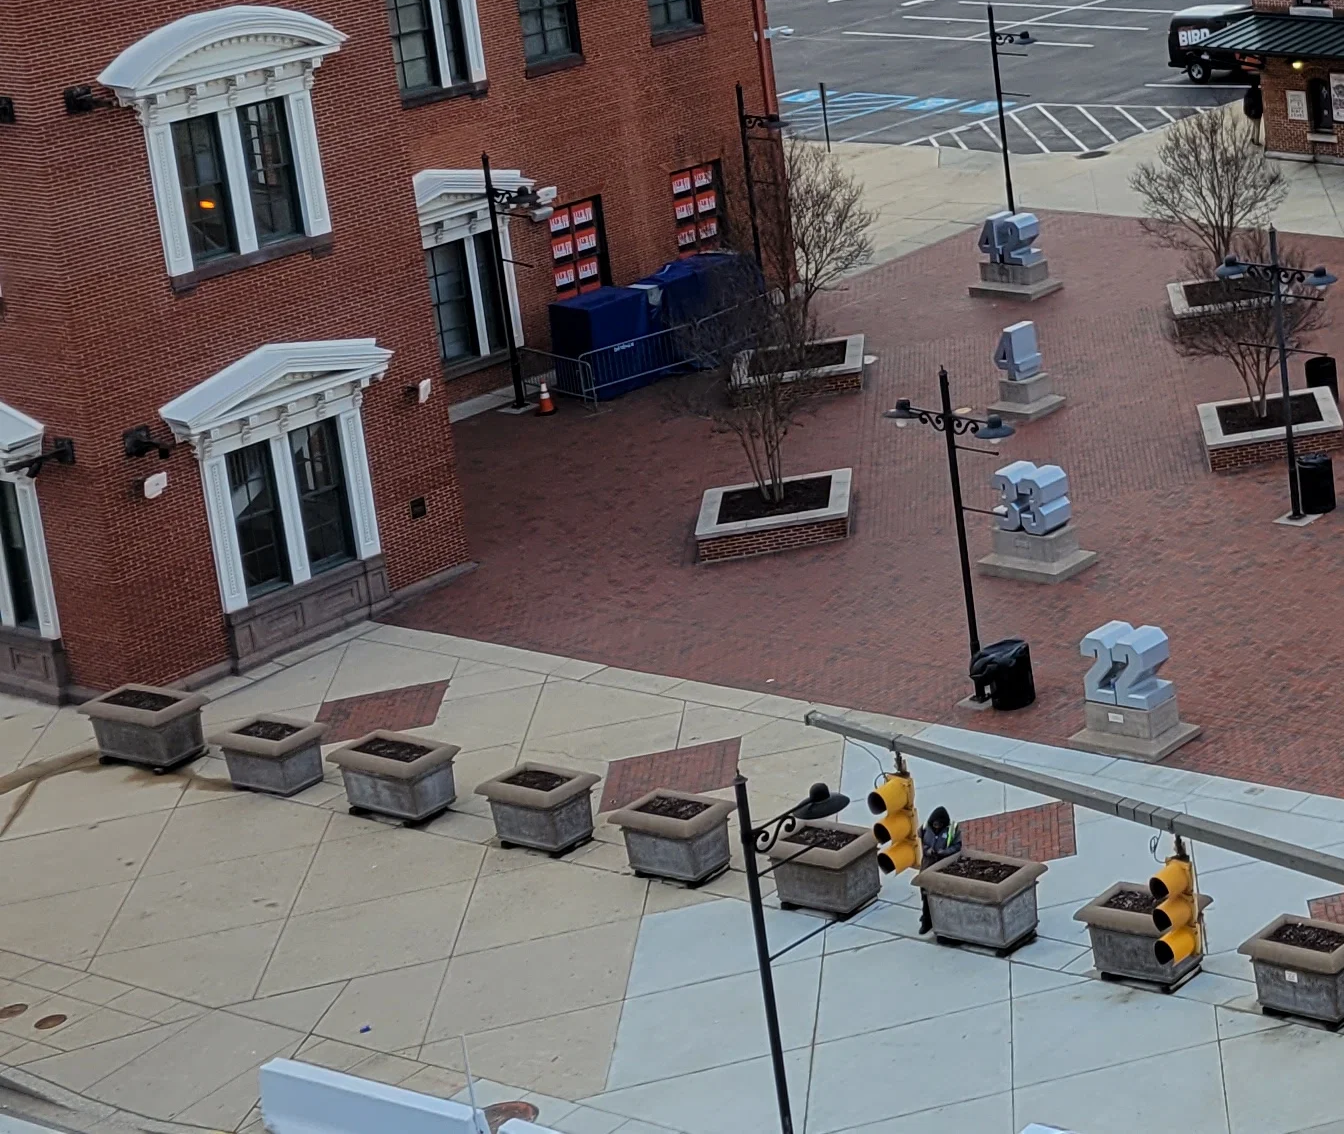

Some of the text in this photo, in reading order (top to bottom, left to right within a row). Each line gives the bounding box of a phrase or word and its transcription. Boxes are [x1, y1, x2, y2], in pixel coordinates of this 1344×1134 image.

[1178, 27, 1210, 47] BIRD
[978, 211, 1042, 266] 42
[994, 321, 1042, 381] 4
[992, 460, 1071, 536] 33
[1080, 620, 1175, 710] 22
